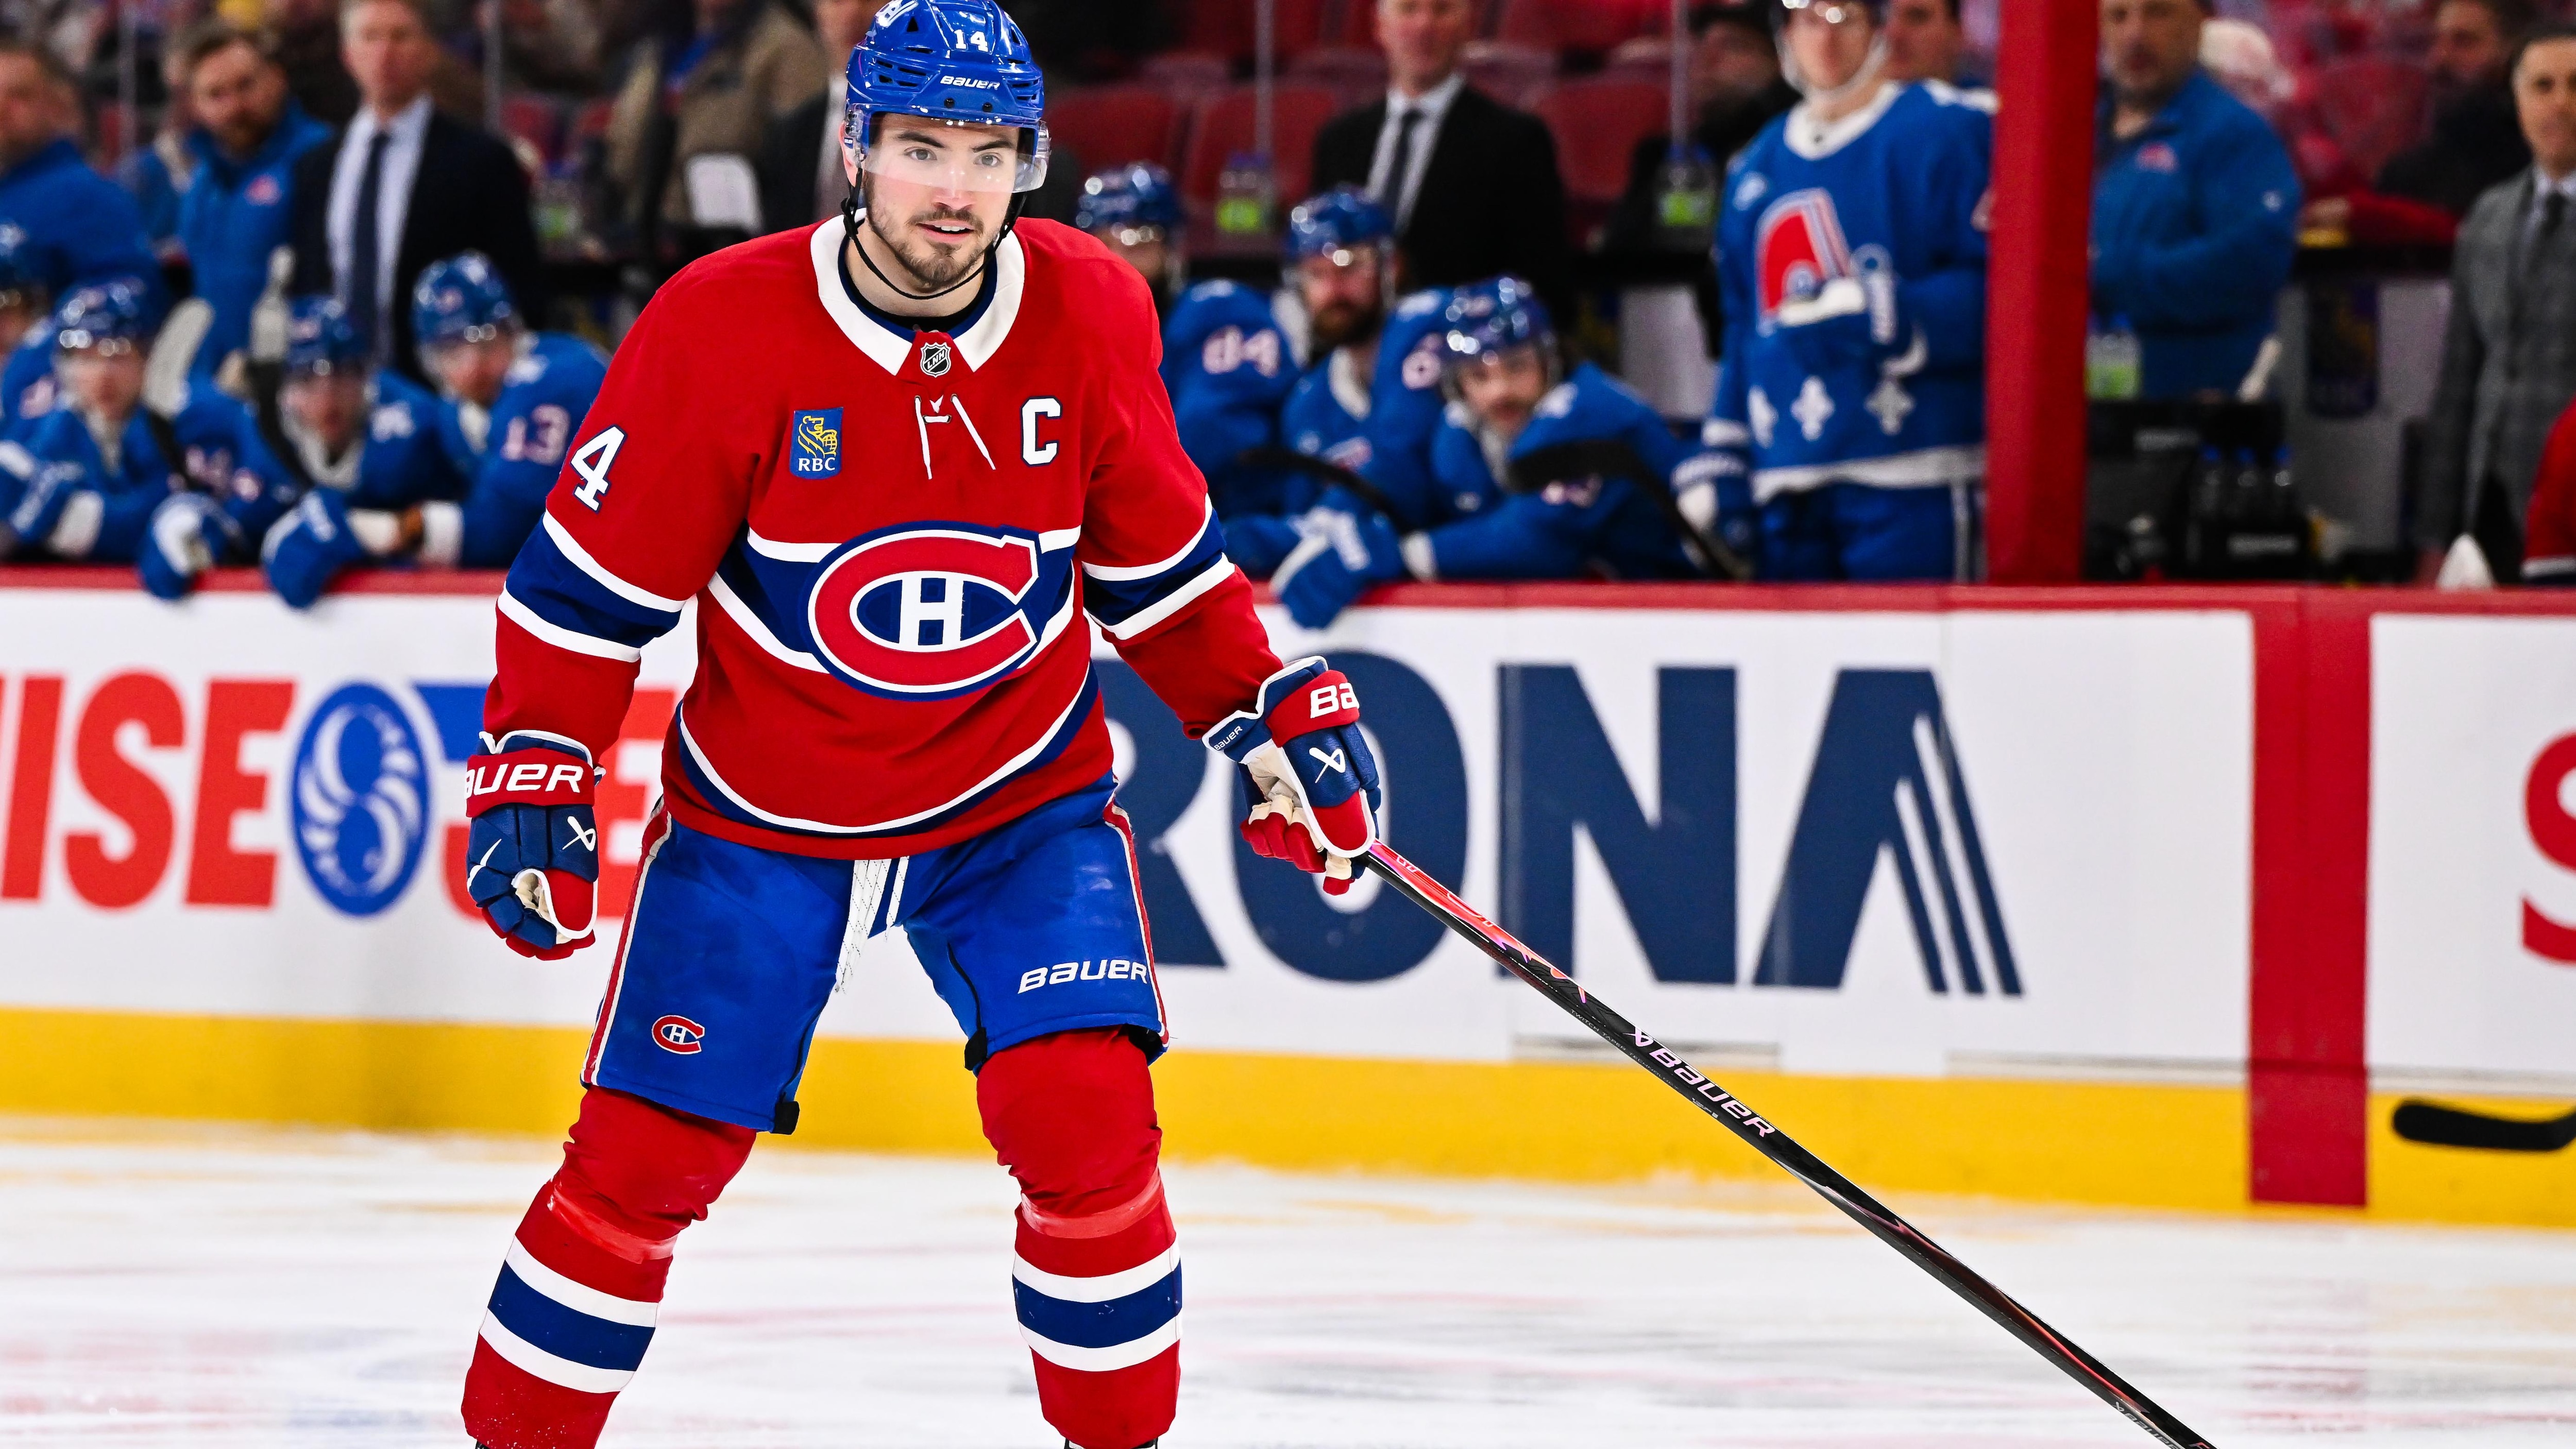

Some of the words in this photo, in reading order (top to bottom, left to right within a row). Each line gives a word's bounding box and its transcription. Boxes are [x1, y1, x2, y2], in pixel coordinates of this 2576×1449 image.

[953, 29, 988, 52] 14
[927, 350, 945, 370] LNH
[1020, 396, 1062, 467] C
[569, 424, 627, 514] 4
[798, 457, 836, 471] RBC
[0, 671, 298, 909] ISE
